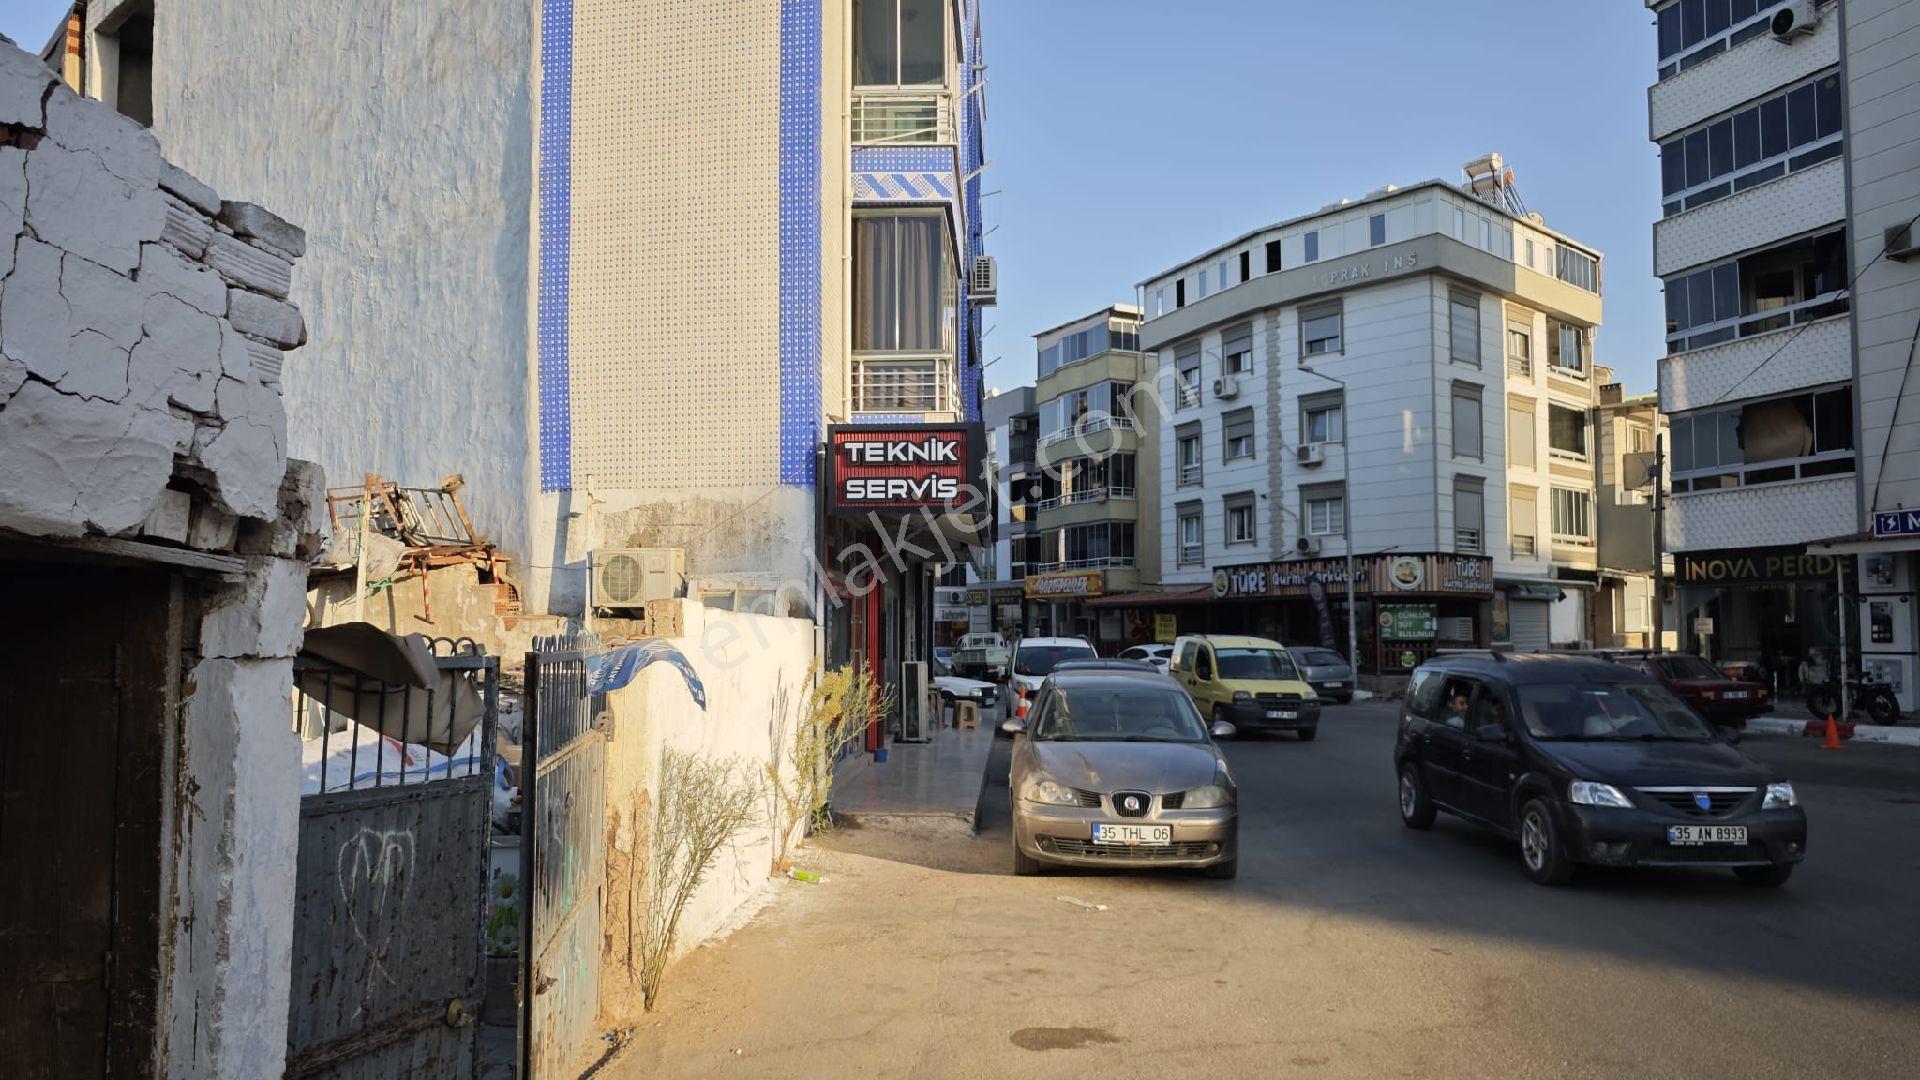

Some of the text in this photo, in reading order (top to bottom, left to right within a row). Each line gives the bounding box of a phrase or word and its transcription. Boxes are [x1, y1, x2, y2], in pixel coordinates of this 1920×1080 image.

[845, 438, 958, 462] TEKNİK
[846, 474, 957, 499] SERVİS
[1455, 559, 1480, 577] TÜRE
[1685, 554, 1851, 581] İNOVA PERDE
[1231, 570, 1267, 593] TÜRE
[1101, 826, 1116, 839] 35
[1121, 827, 1147, 840] THL
[1675, 827, 1690, 840] 35
[1698, 827, 1712, 840] AN
